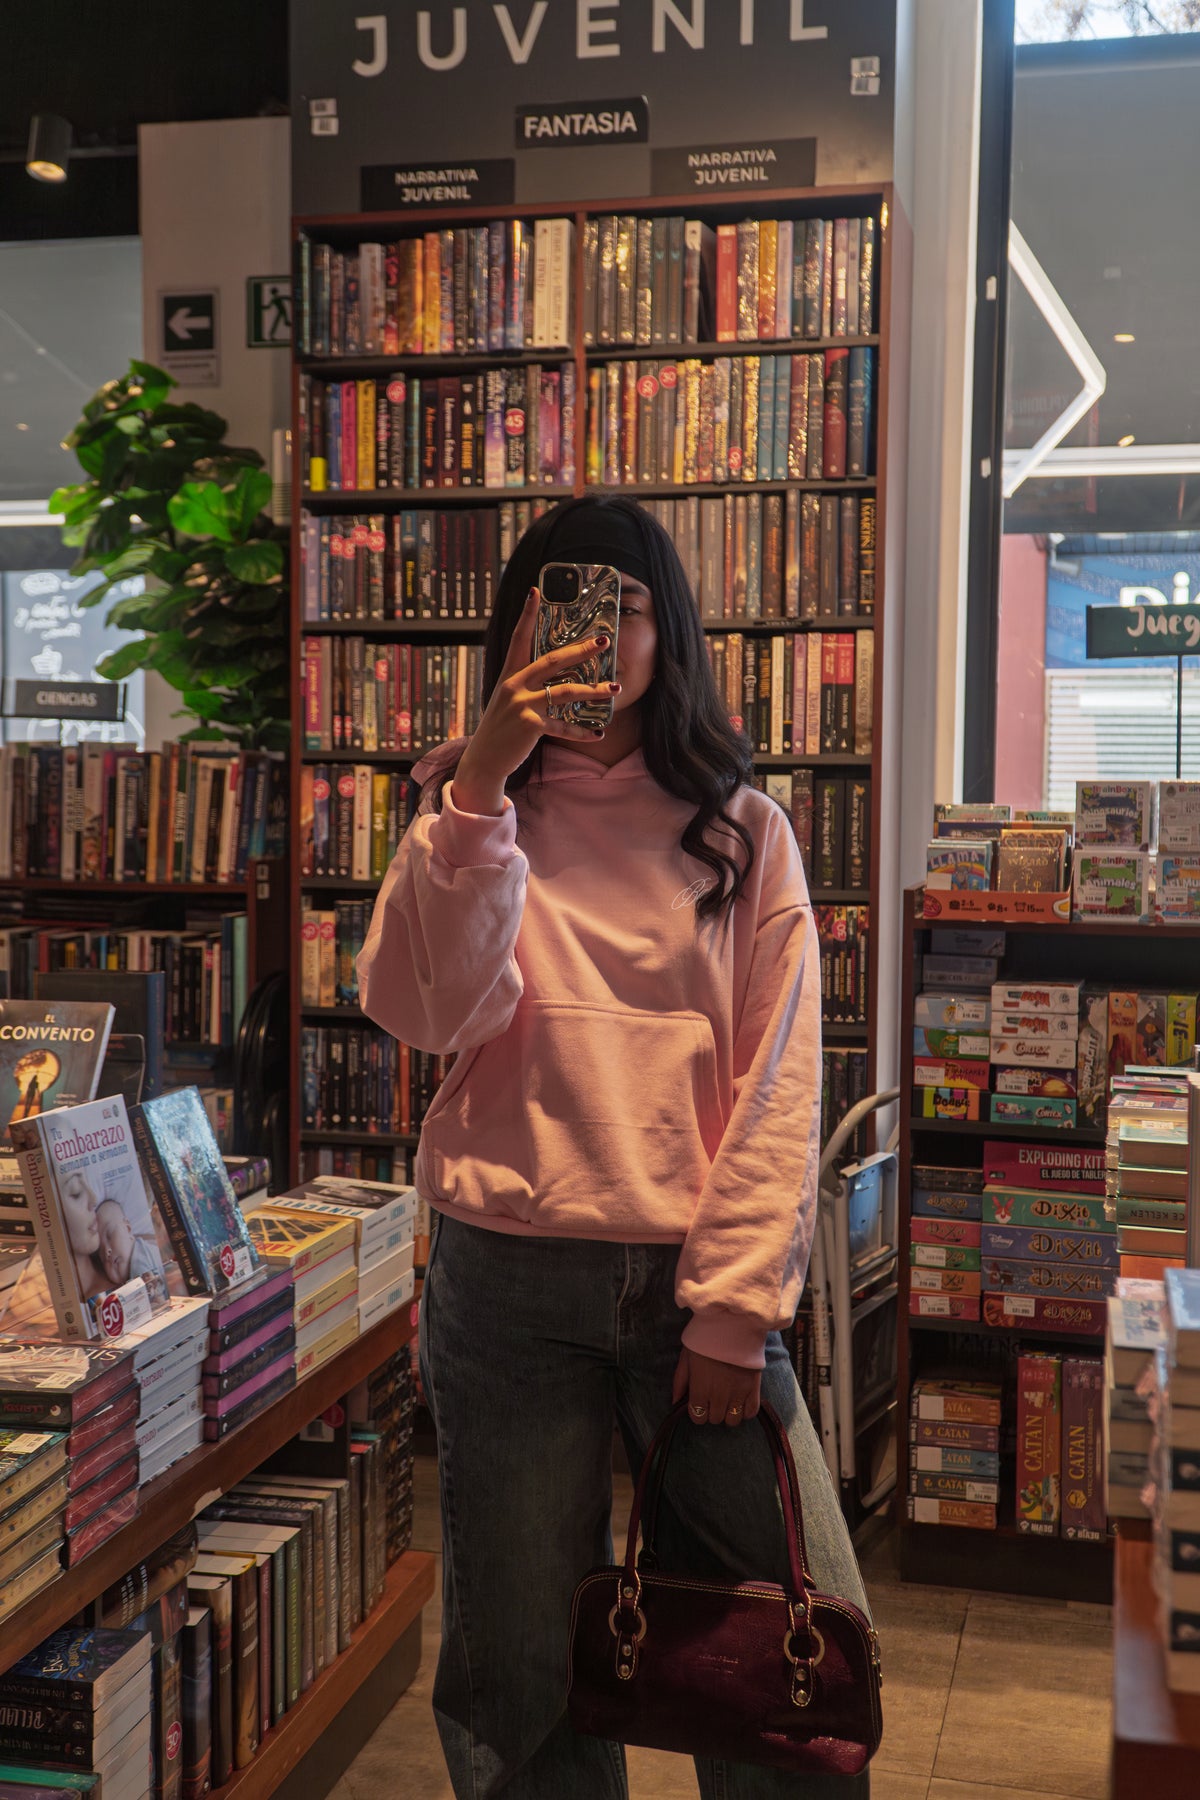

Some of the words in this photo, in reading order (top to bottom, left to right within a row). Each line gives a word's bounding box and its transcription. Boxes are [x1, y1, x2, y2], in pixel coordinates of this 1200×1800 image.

[352, 0, 828, 77] JUVENIL
[524, 111, 638, 139] FANTASIA
[688, 148, 777, 168] NARRATIVA
[395, 168, 479, 185] NARRATIVA
[695, 166, 769, 185] JUVENIL
[402, 185, 472, 203] JUVENIL
[36, 690, 98, 707] CIENCIAS
[930, 850, 980, 869] LLAMA
[45, 1014, 55, 1023] EL
[0, 1026, 95, 1042] CONVENTO
[54, 1124, 125, 1161] embarazo
[59, 1156, 90, 1174] semana
[98, 1144, 128, 1161] semana
[1019, 1149, 1081, 1168] EXPLODING
[1051, 1169, 1071, 1179] JUEGO
[1071, 1170, 1081, 1179] DE
[26, 1153, 52, 1228] embarazo
[0, 1344, 124, 1361] SILVERC
[943, 1403, 972, 1414] ATAN
[937, 1427, 970, 1439] CATAN
[1024, 1415, 1042, 1472] CATAN
[1069, 1424, 1085, 1480] CATAN
[942, 1454, 971, 1464] ATAN
